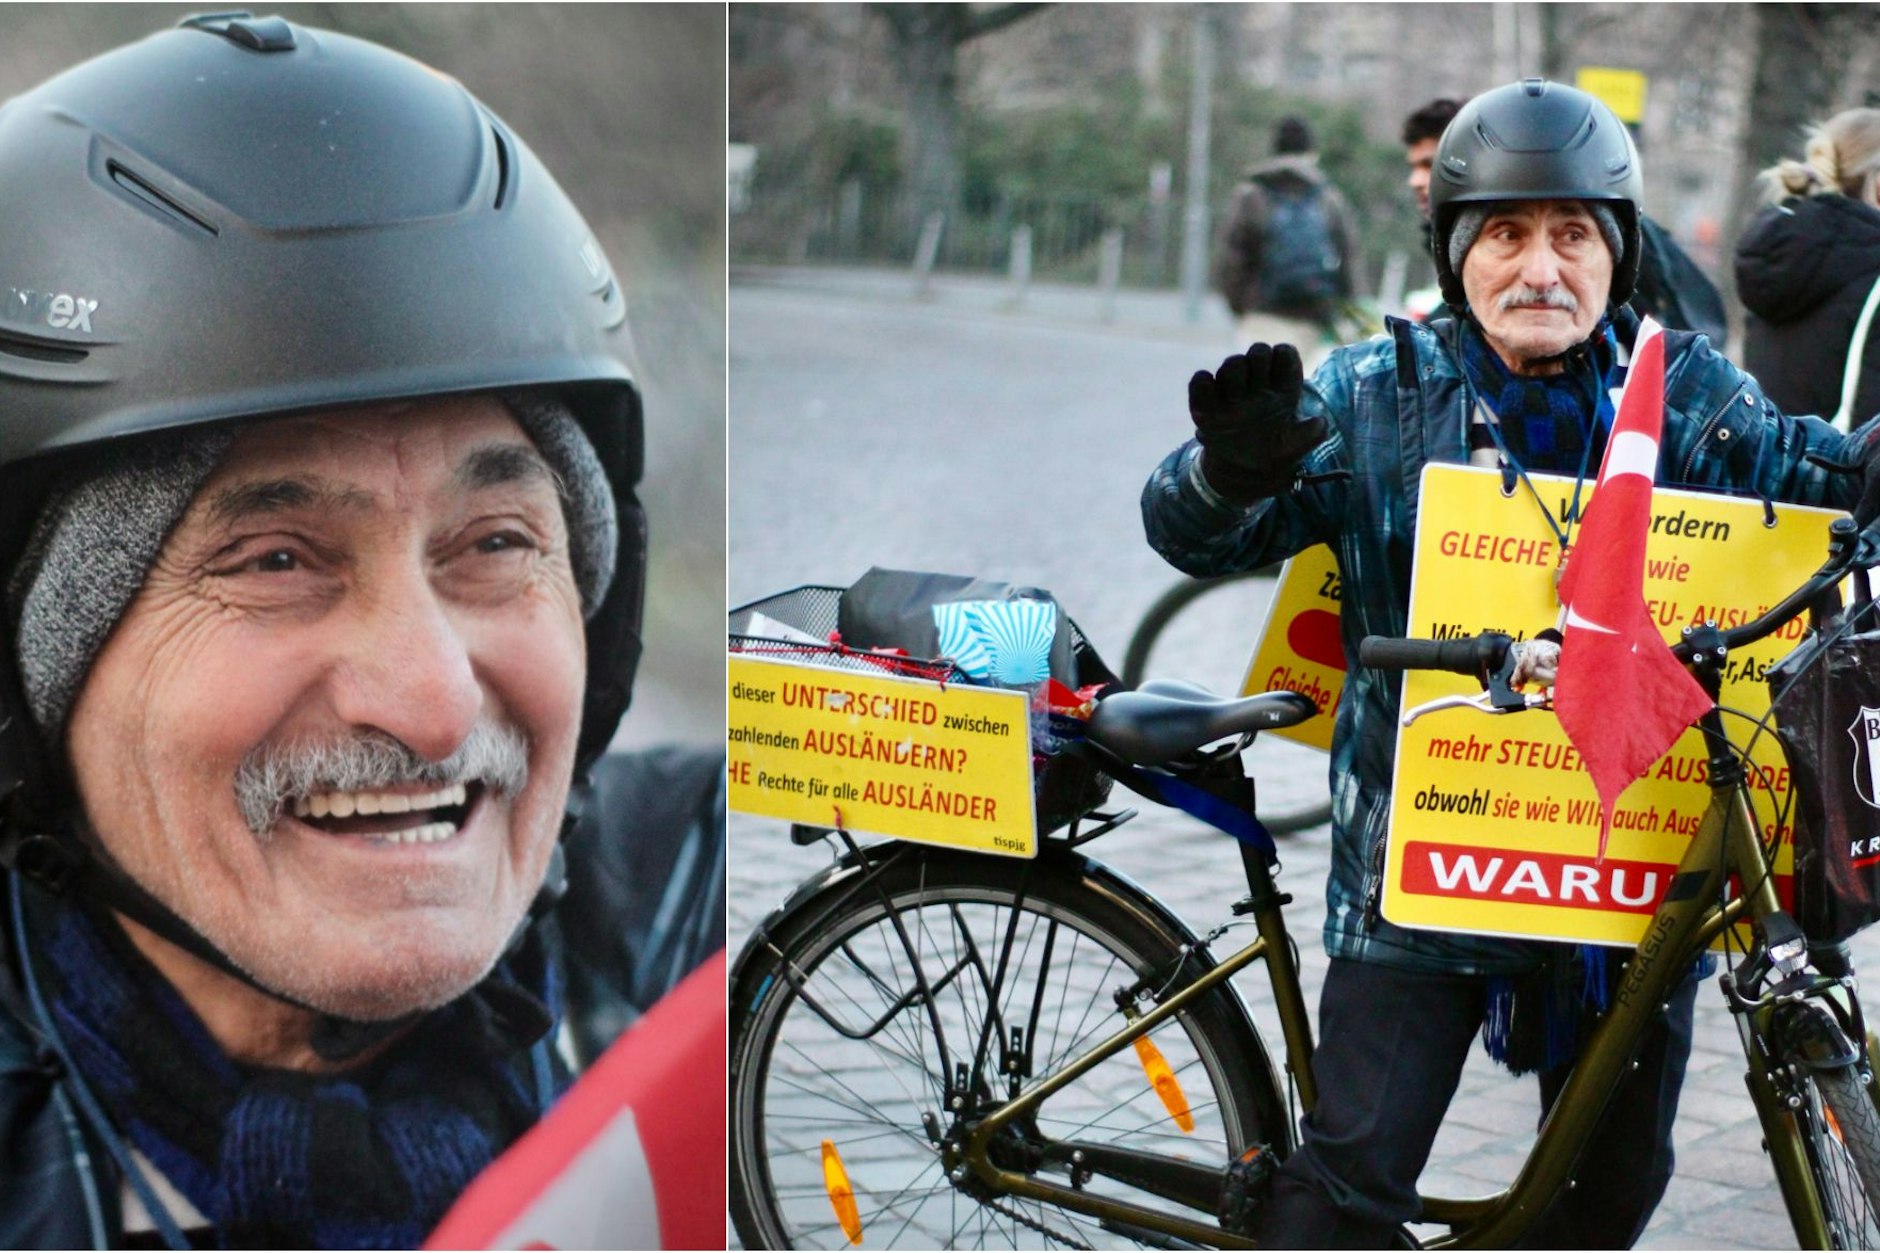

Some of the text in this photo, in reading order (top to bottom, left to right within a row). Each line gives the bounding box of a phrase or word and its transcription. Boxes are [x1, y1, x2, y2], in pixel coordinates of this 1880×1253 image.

[1440, 531, 1553, 567] GLEICHE
[1648, 510, 1731, 541] rdern
[1647, 556, 1691, 582] wie
[732, 682, 775, 703] dieser
[943, 713, 1009, 736] zwischen
[729, 726, 967, 774] zahlenden AUSLÄNDERN?
[1427, 735, 1492, 762] mehr
[758, 771, 805, 793] Rechte
[808, 777, 829, 798] für
[833, 783, 858, 801] alle
[863, 780, 996, 822] AUSLÄNDER
[1414, 785, 1490, 815] obwohl
[1492, 793, 1520, 819] sie
[1526, 797, 1560, 822] wie
[1612, 806, 1659, 832] auch
[1429, 851, 1732, 906] WARU
[1618, 912, 1676, 1008] PEGASUS
